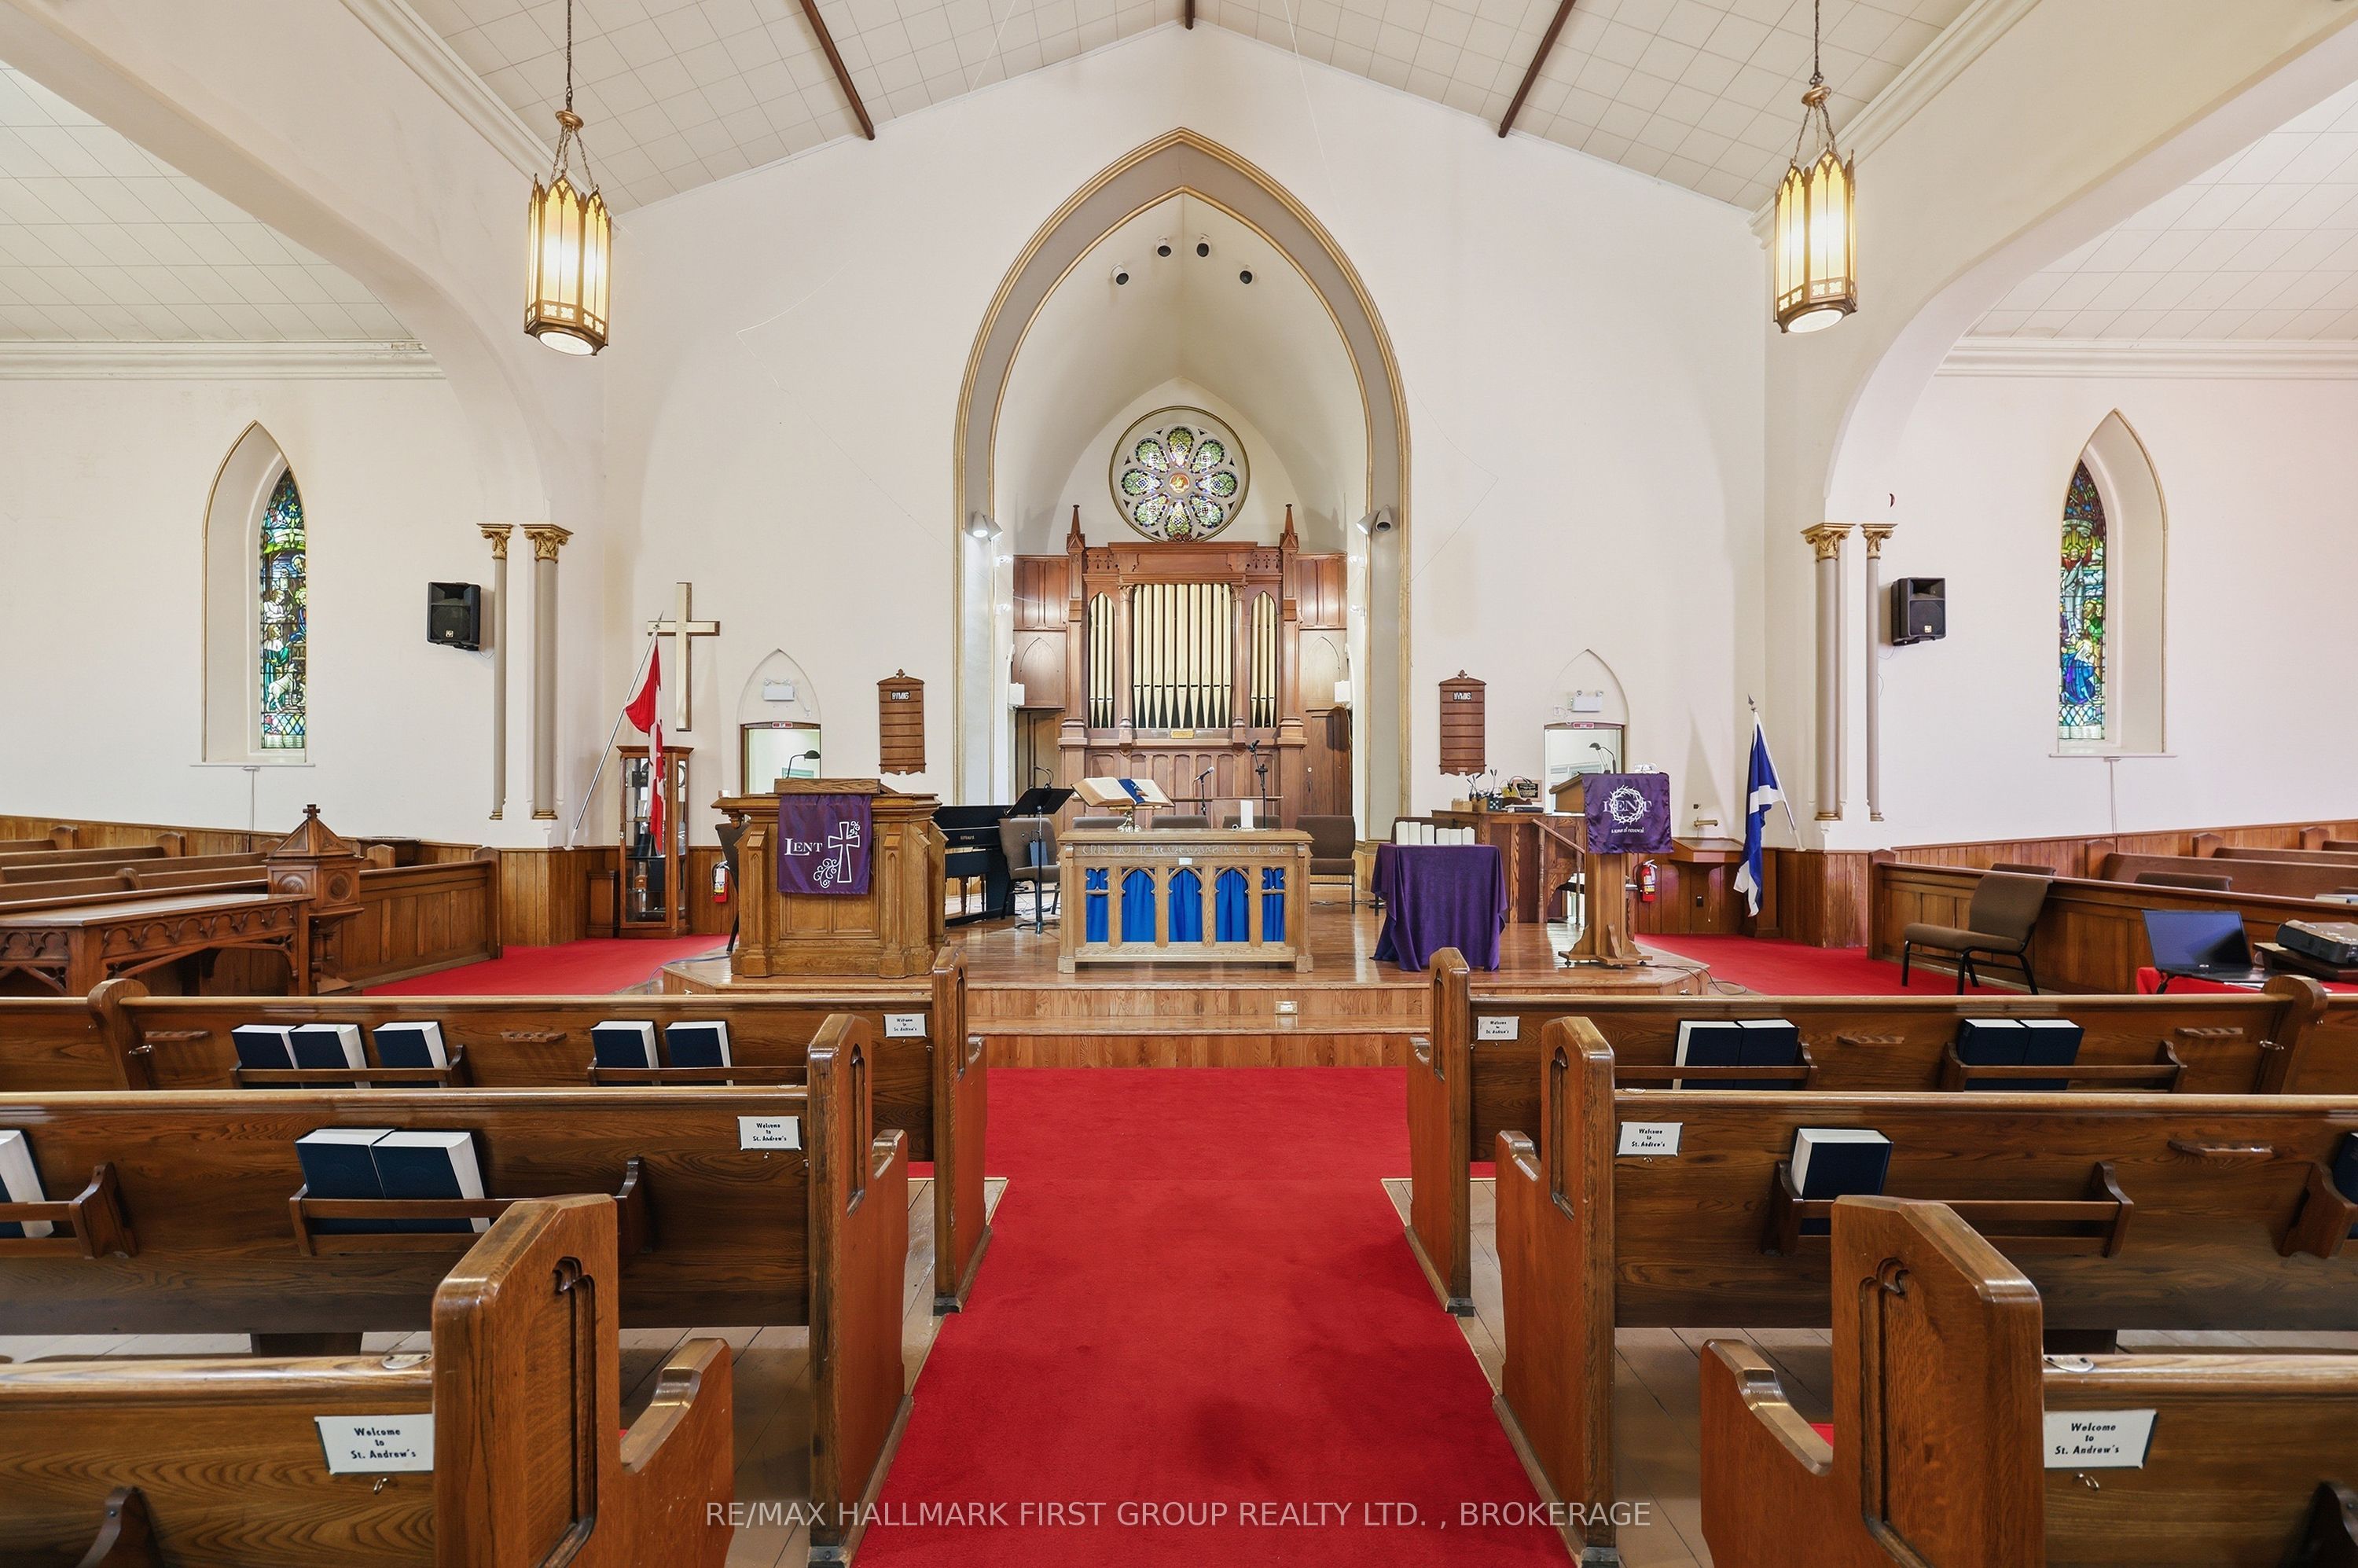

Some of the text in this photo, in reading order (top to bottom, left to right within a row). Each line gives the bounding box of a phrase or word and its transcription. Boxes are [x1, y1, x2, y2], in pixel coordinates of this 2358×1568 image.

[1603, 799, 1652, 813] LENT
[784, 837, 823, 857] LENT
[354, 1427, 401, 1436] Welcome
[2070, 1423, 2116, 1432] Welcome
[351, 1449, 417, 1460] St. Andrew's
[2055, 1445, 2120, 1455] St. Andrew's
